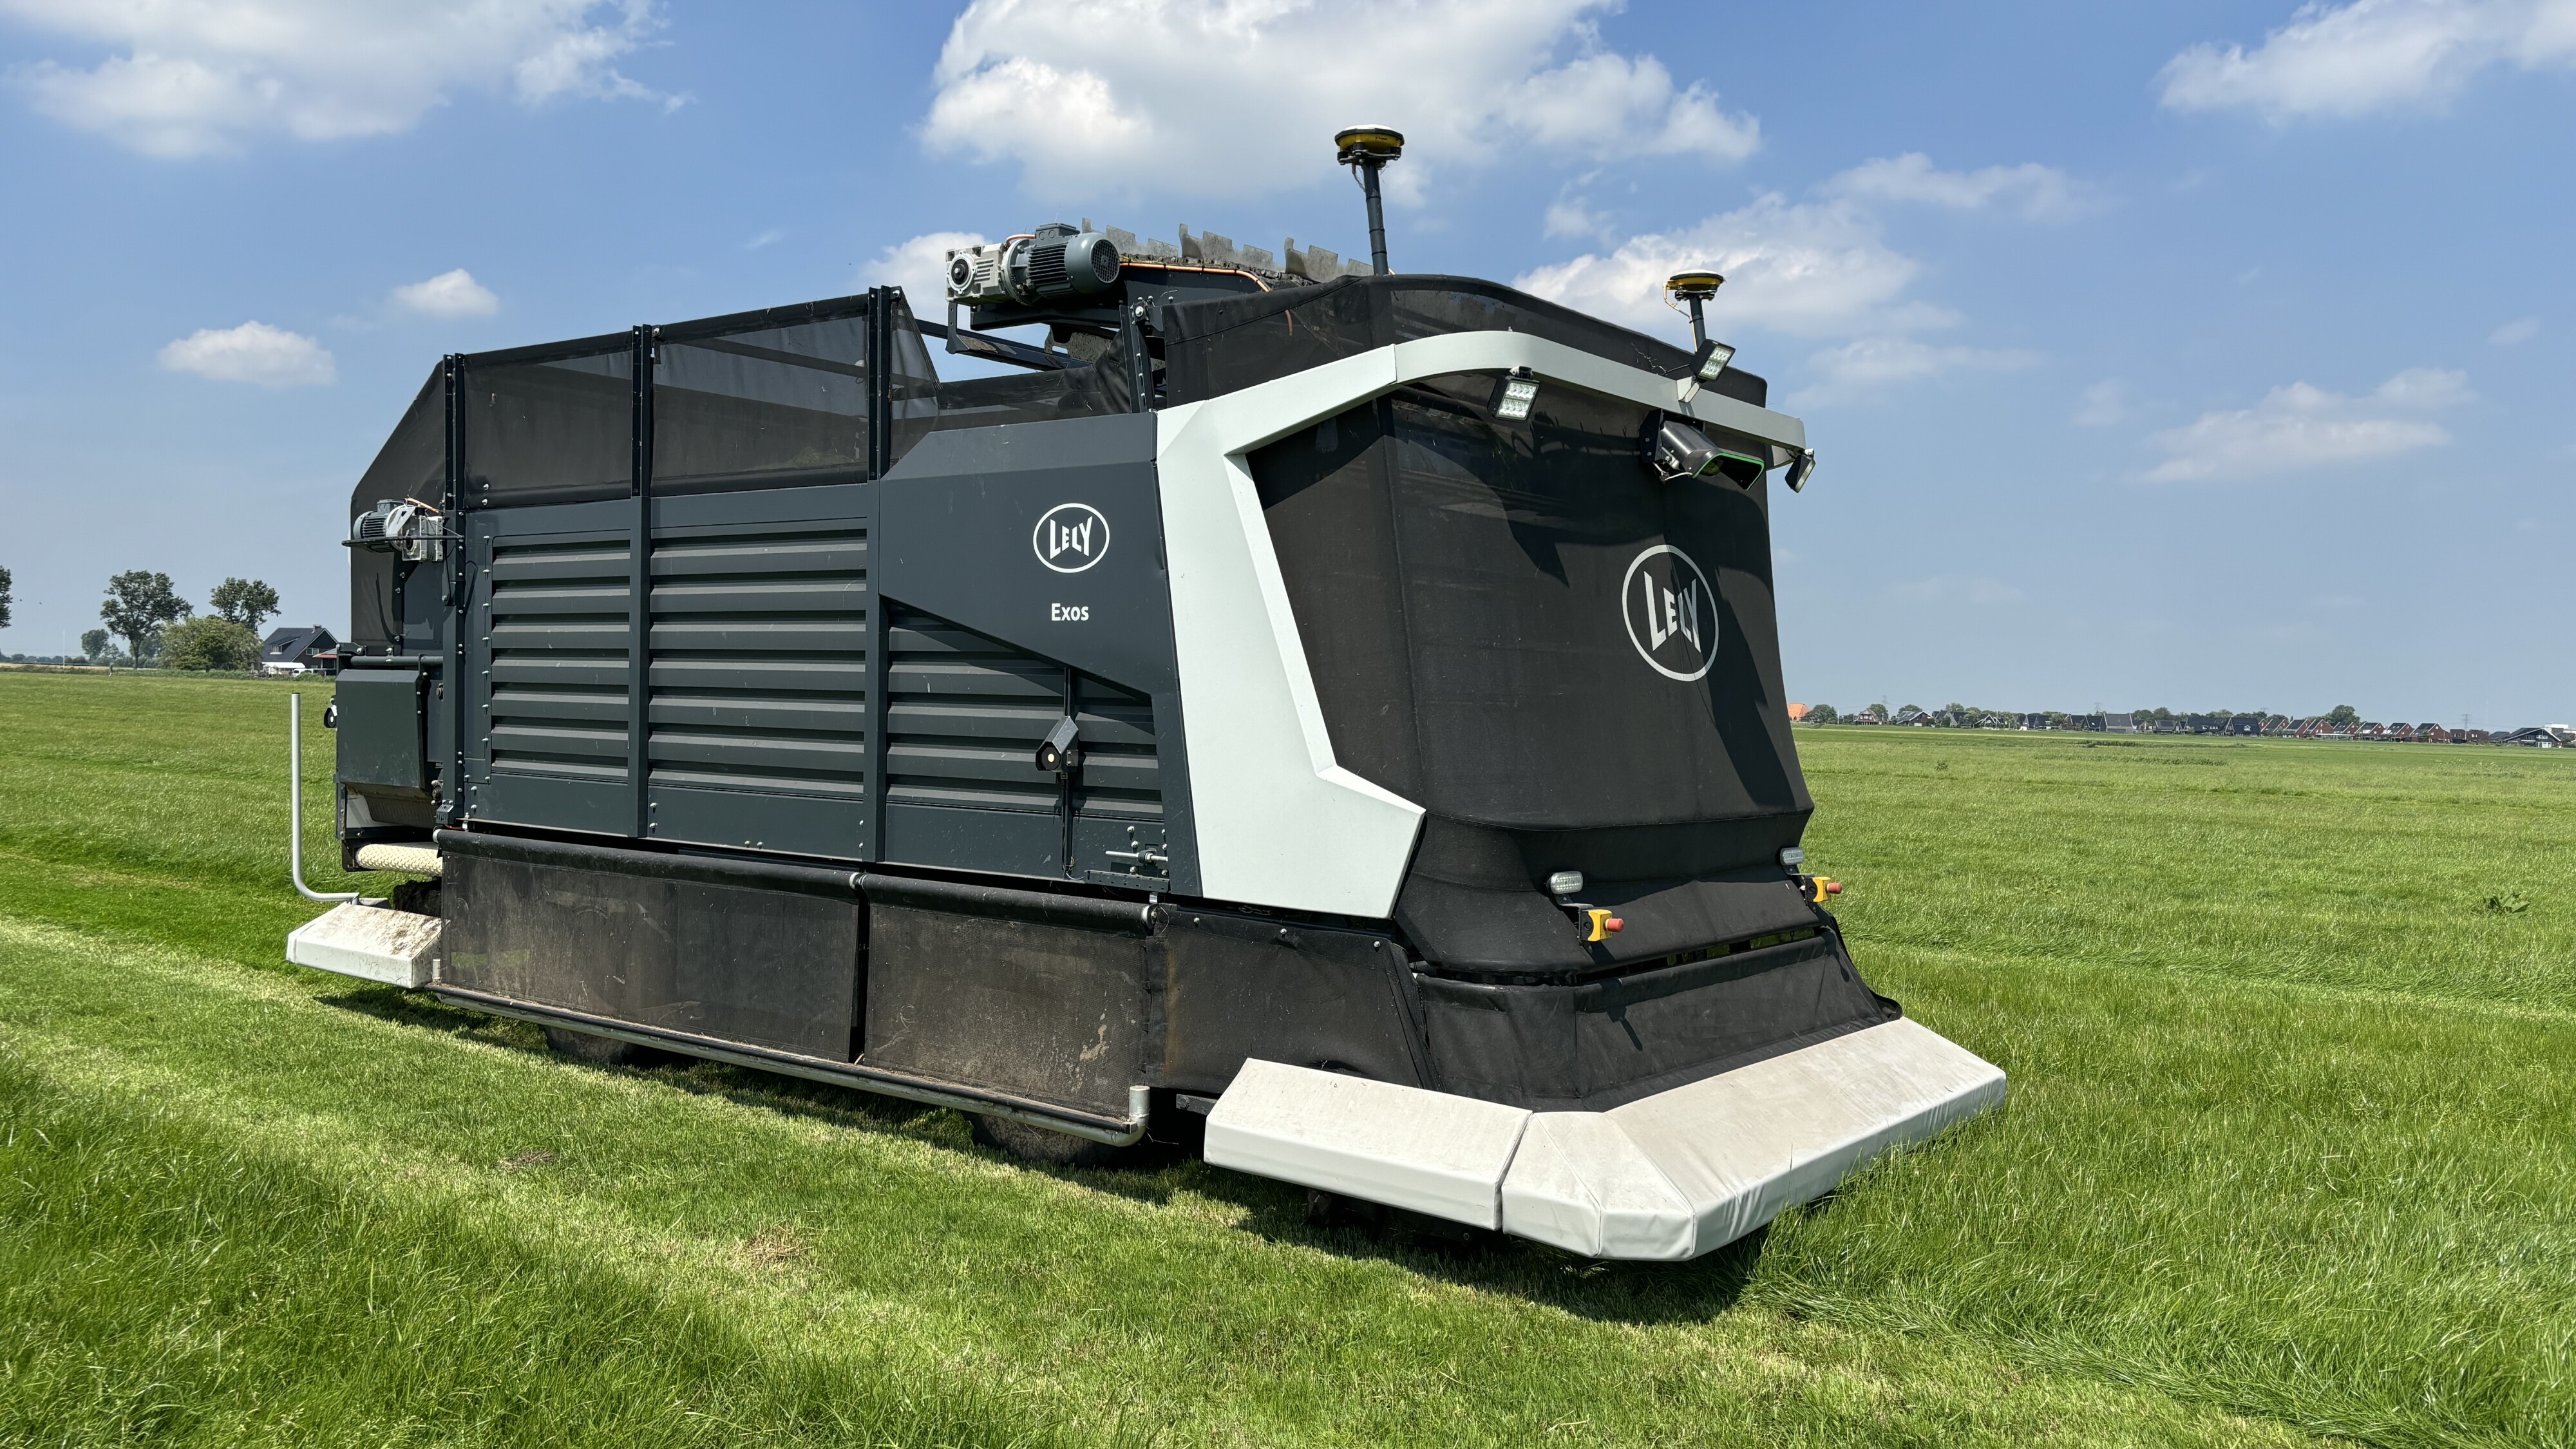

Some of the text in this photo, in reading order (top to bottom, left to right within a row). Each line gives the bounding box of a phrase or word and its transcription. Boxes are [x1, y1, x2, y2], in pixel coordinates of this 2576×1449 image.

[1050, 516, 1093, 560] LELY
[1051, 602, 1090, 621] Exos
[1644, 571, 1701, 654] LELY
